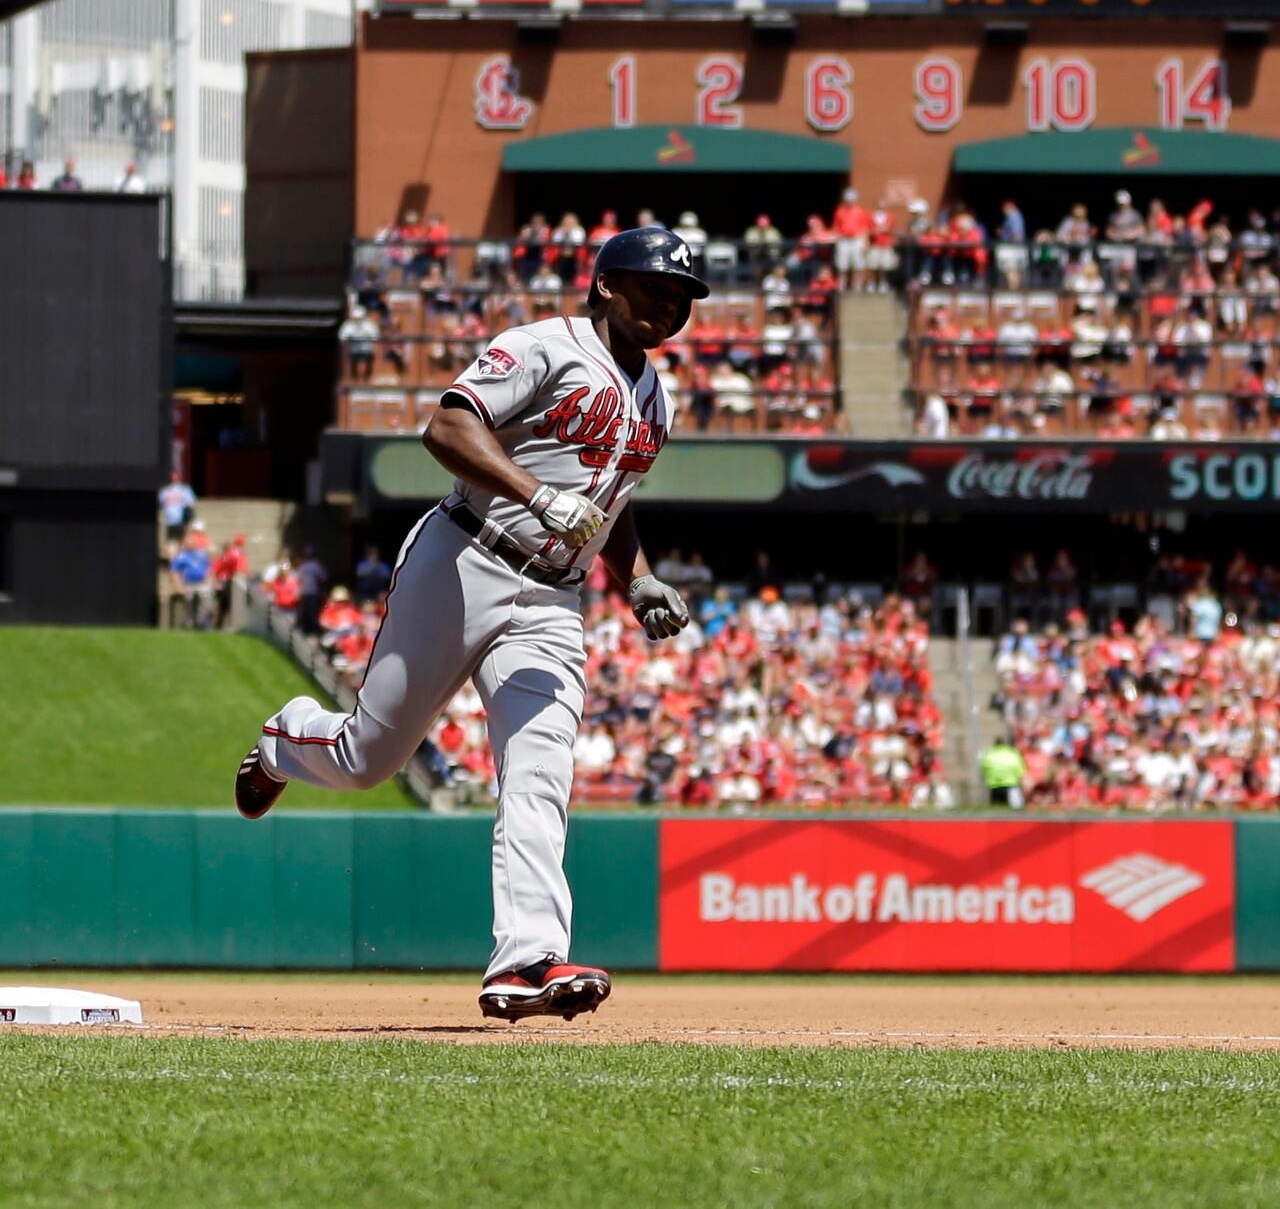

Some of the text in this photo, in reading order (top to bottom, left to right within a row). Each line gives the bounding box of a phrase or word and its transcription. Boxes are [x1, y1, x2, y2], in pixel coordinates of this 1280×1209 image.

[611, 54, 637, 127] 1
[697, 54, 744, 128] 2
[805, 55, 853, 131] 6
[915, 55, 963, 132] 9
[1023, 56, 1097, 133] 10
[1154, 56, 1233, 133] 14
[532, 385, 668, 453] Atlant
[947, 451, 1095, 500] Coca-Cola
[699, 872, 1075, 923] Bank of America
